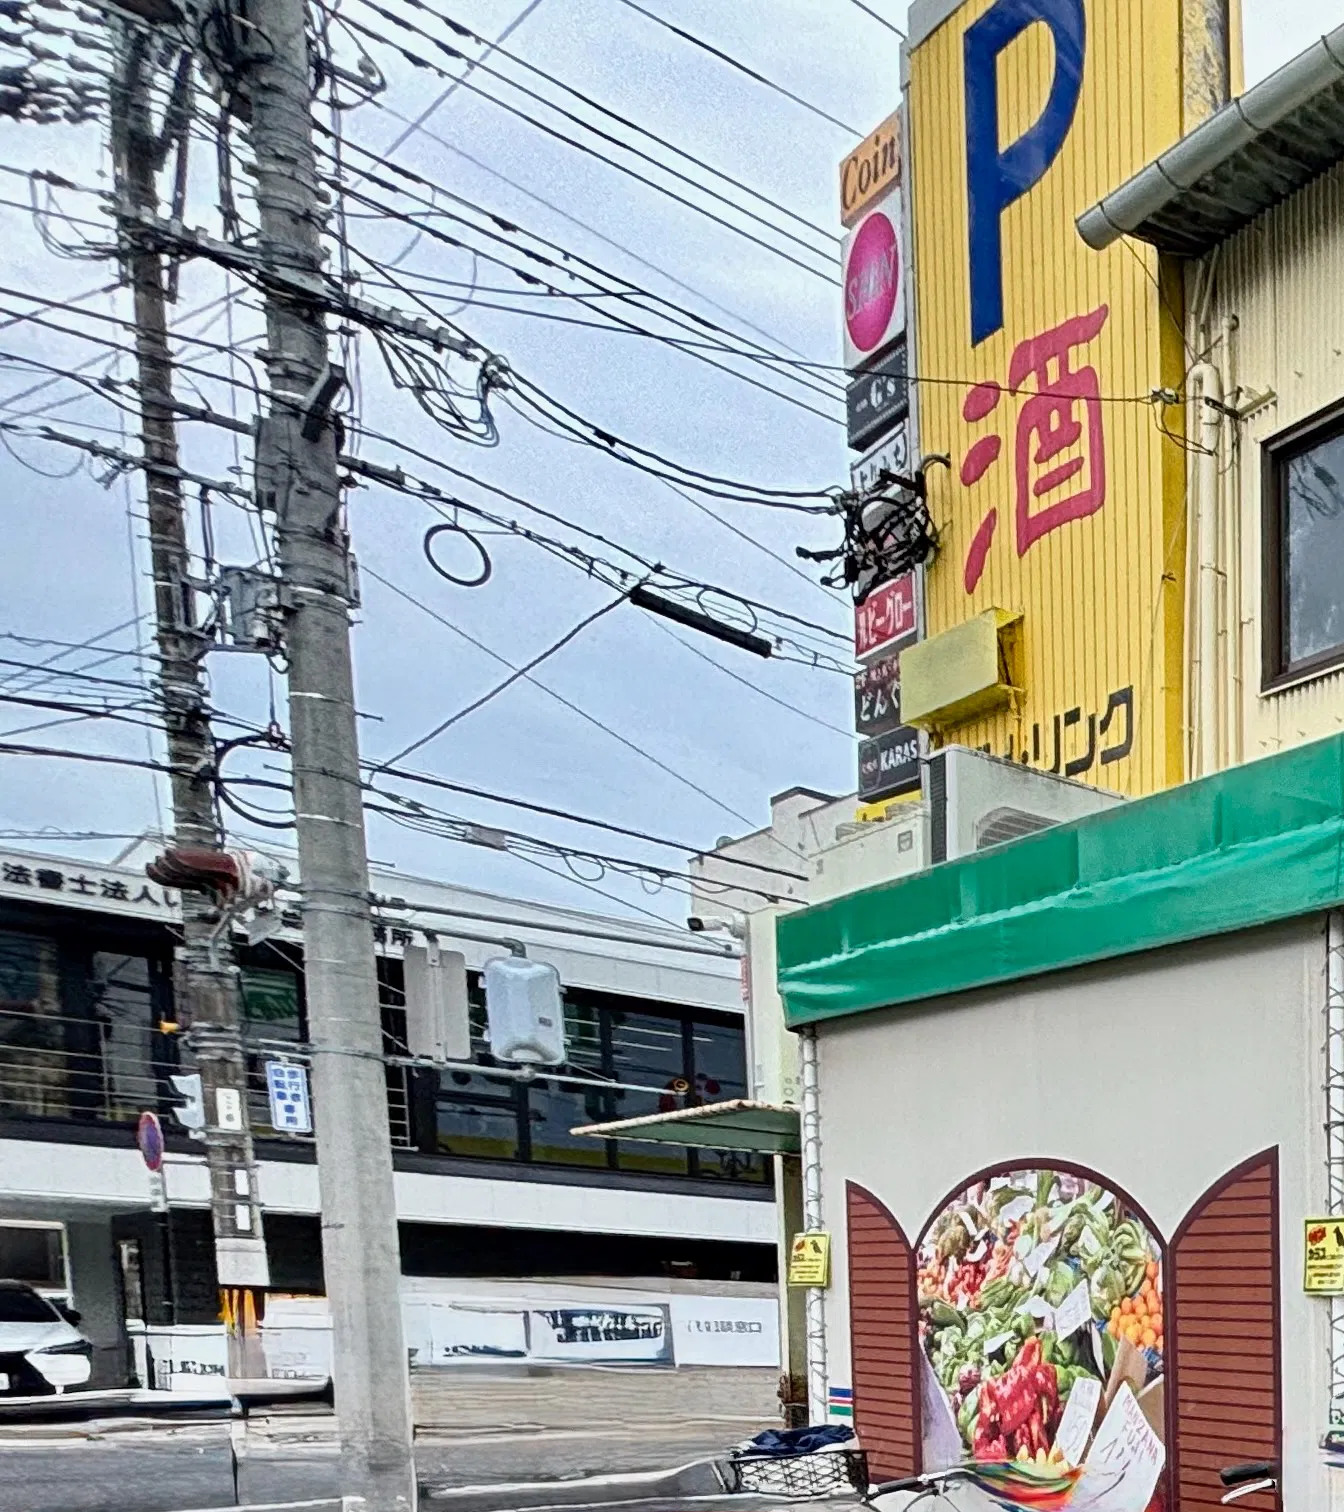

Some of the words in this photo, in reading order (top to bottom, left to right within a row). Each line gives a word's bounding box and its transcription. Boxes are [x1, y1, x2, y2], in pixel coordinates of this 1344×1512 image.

[842, 134, 897, 210] Coin
[963, 0, 1086, 348] P
[960, 304, 1109, 594] 酒
